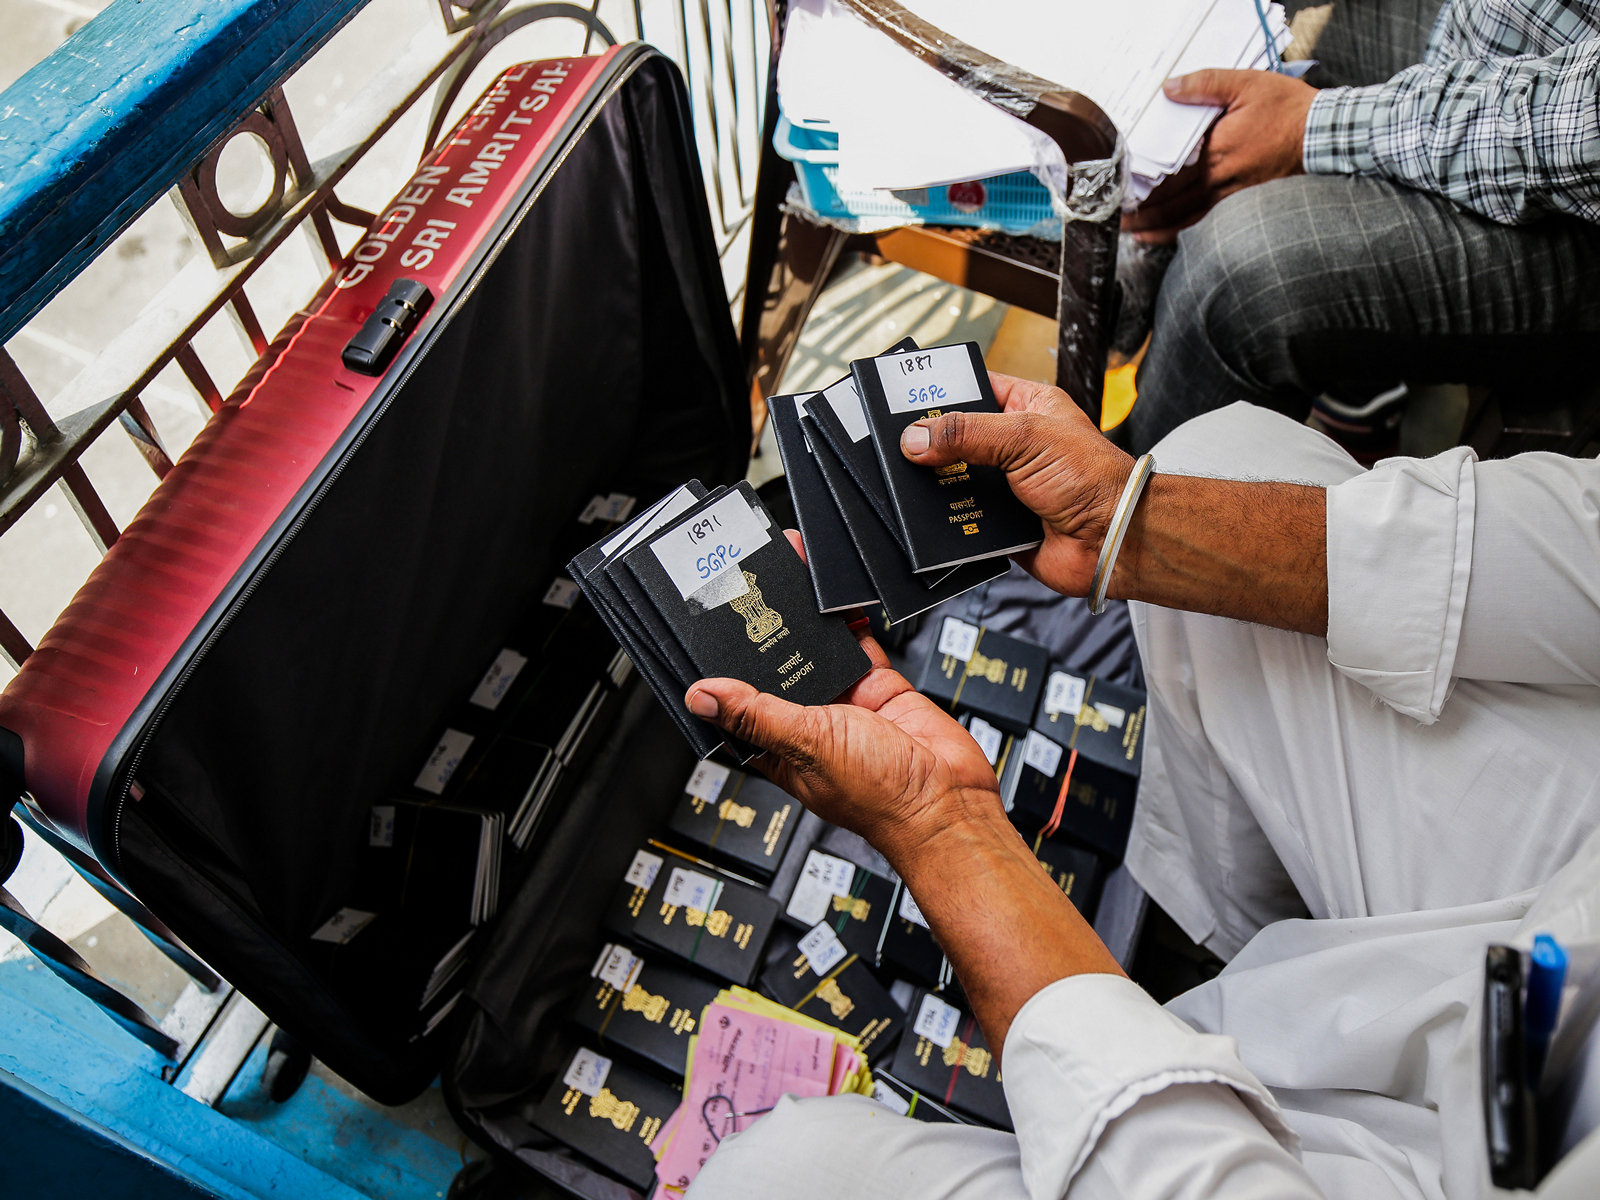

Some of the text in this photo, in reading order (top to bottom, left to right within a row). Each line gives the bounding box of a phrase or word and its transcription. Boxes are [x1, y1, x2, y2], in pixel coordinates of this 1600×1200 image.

[335, 165, 450, 289] GOLDEN
[400, 219, 456, 270] SRI
[900, 355, 932, 375] 1887
[949, 497, 976, 510] पासपोर्ट
[949, 510, 983, 523] PASSPORT
[687, 514, 722, 545] 1891
[777, 651, 804, 674] पासपोर्ट
[781, 661, 815, 690] PASSPORT
